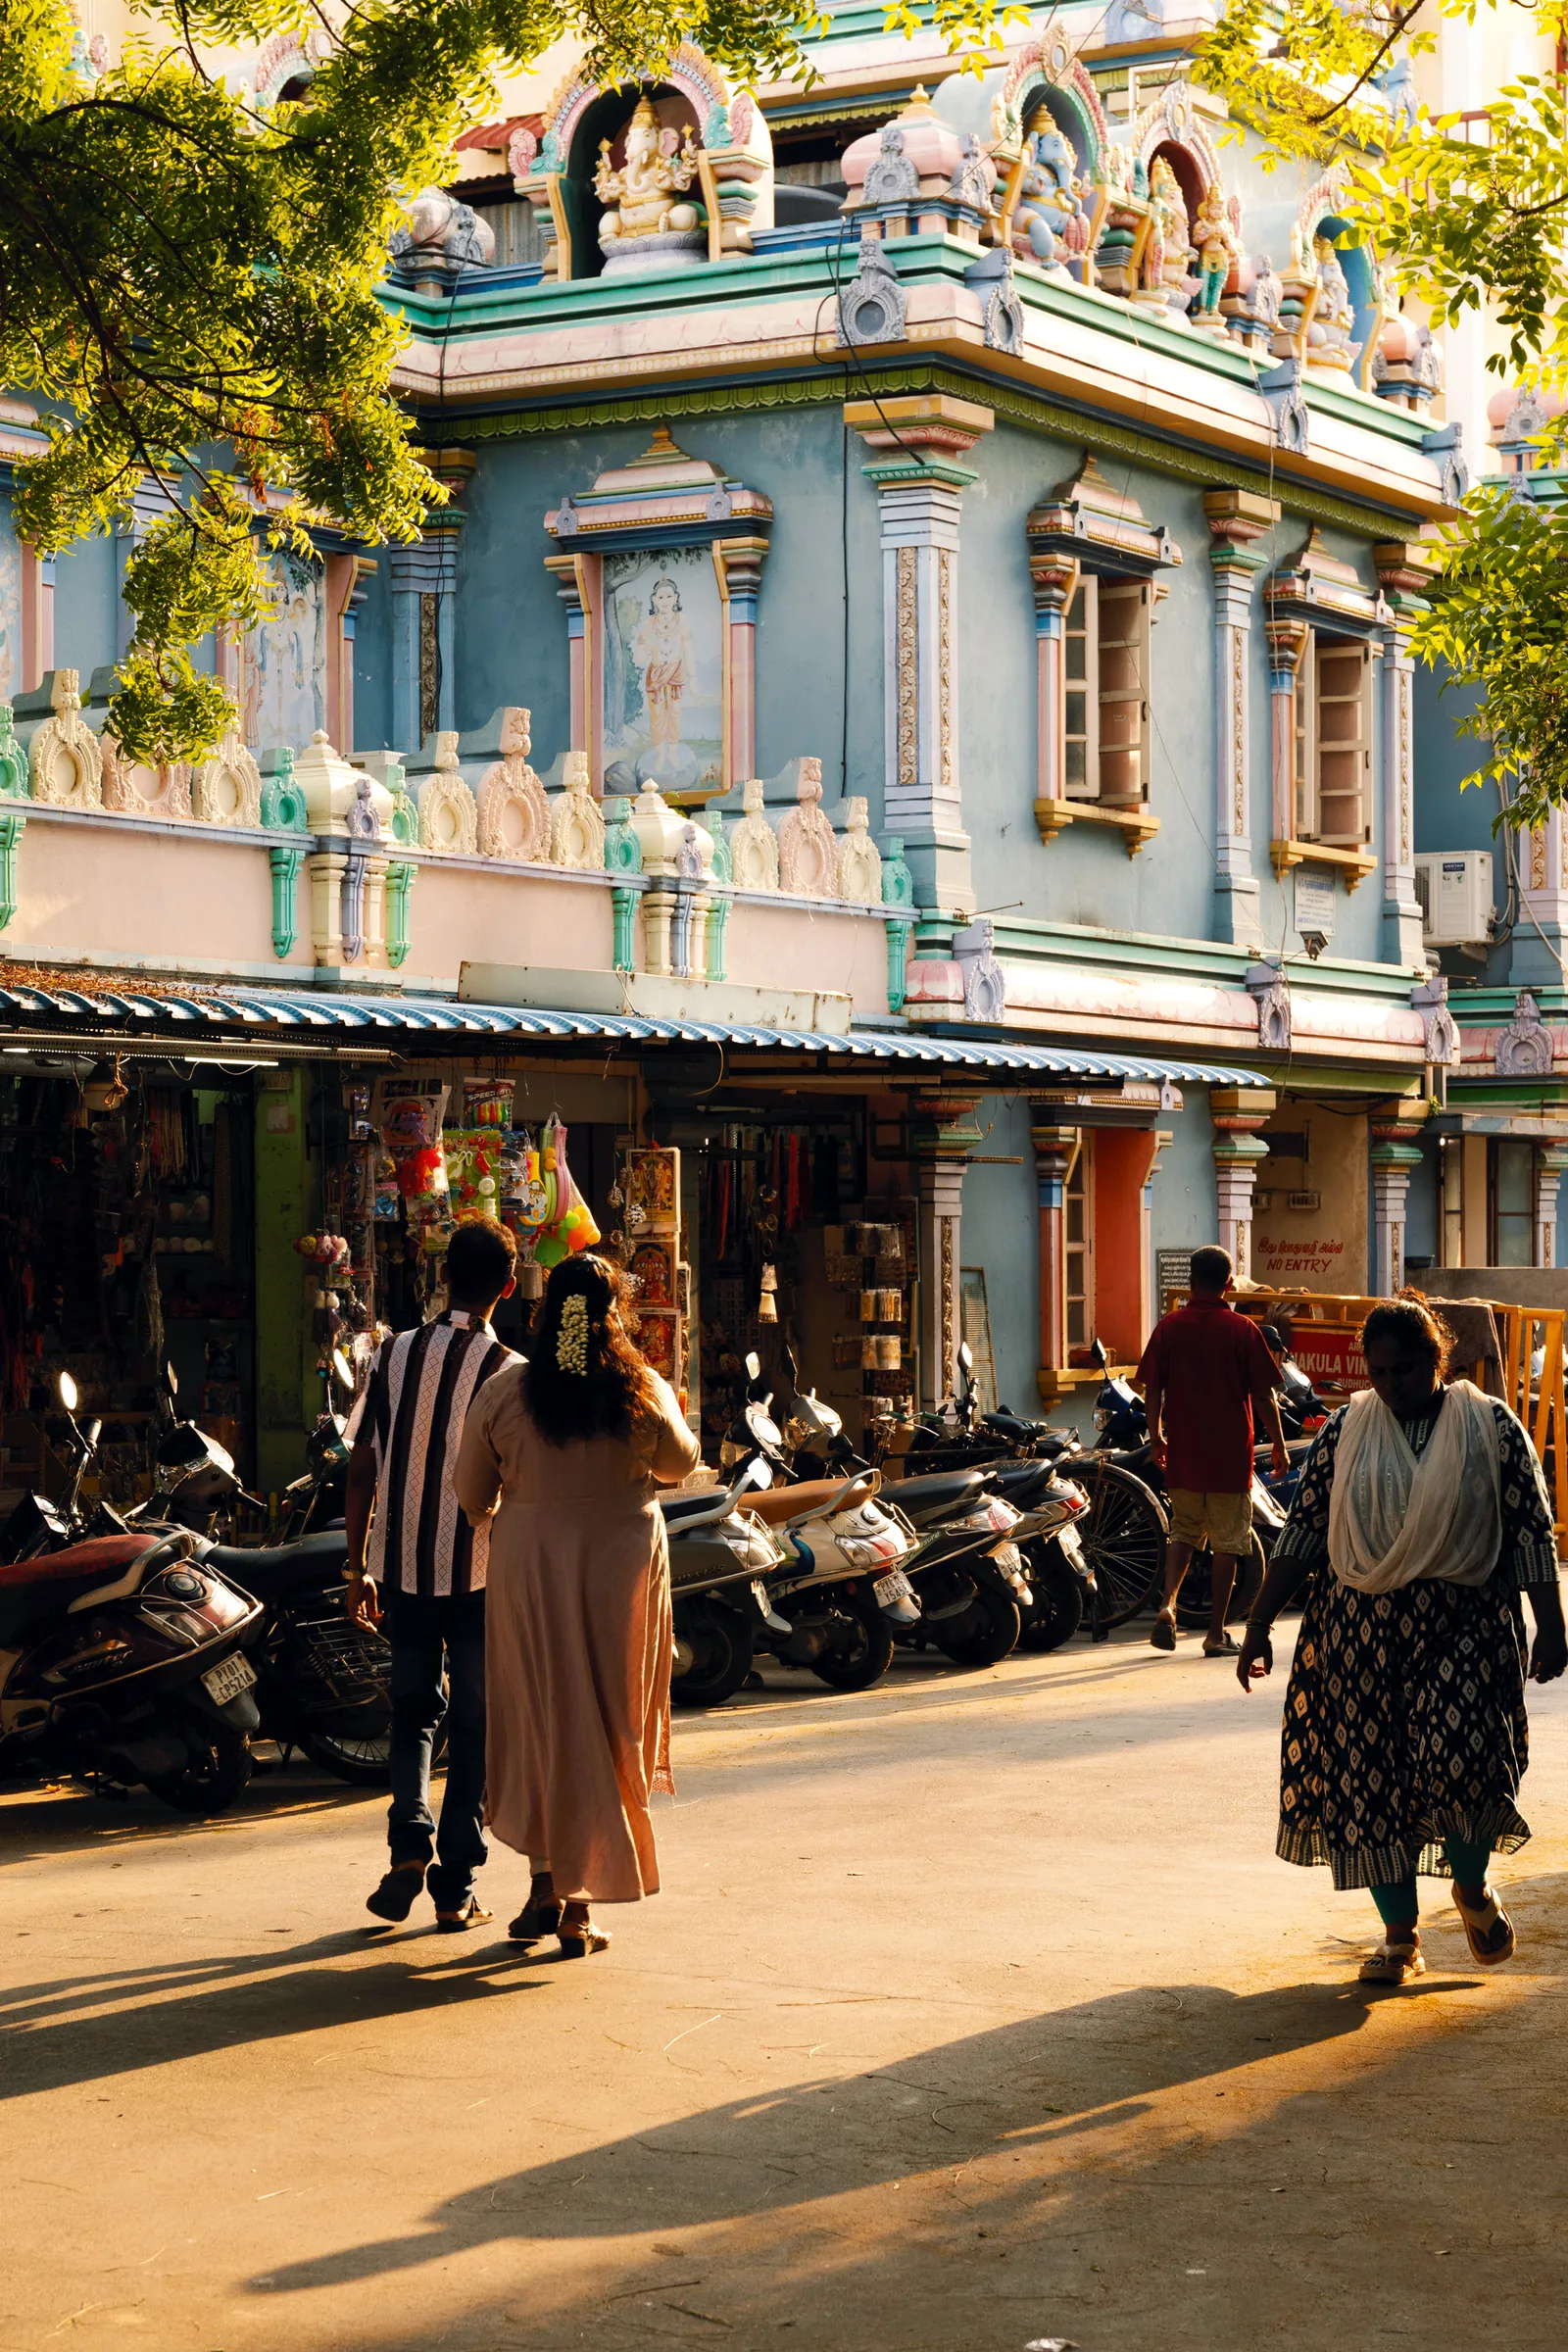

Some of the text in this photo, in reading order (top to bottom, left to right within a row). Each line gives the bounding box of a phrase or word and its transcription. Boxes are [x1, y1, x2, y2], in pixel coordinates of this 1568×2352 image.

[1266, 1258, 1333, 1273] NO ENTRY
[215, 1660, 240, 1684] PY01
[219, 1670, 254, 1700] CP5214
